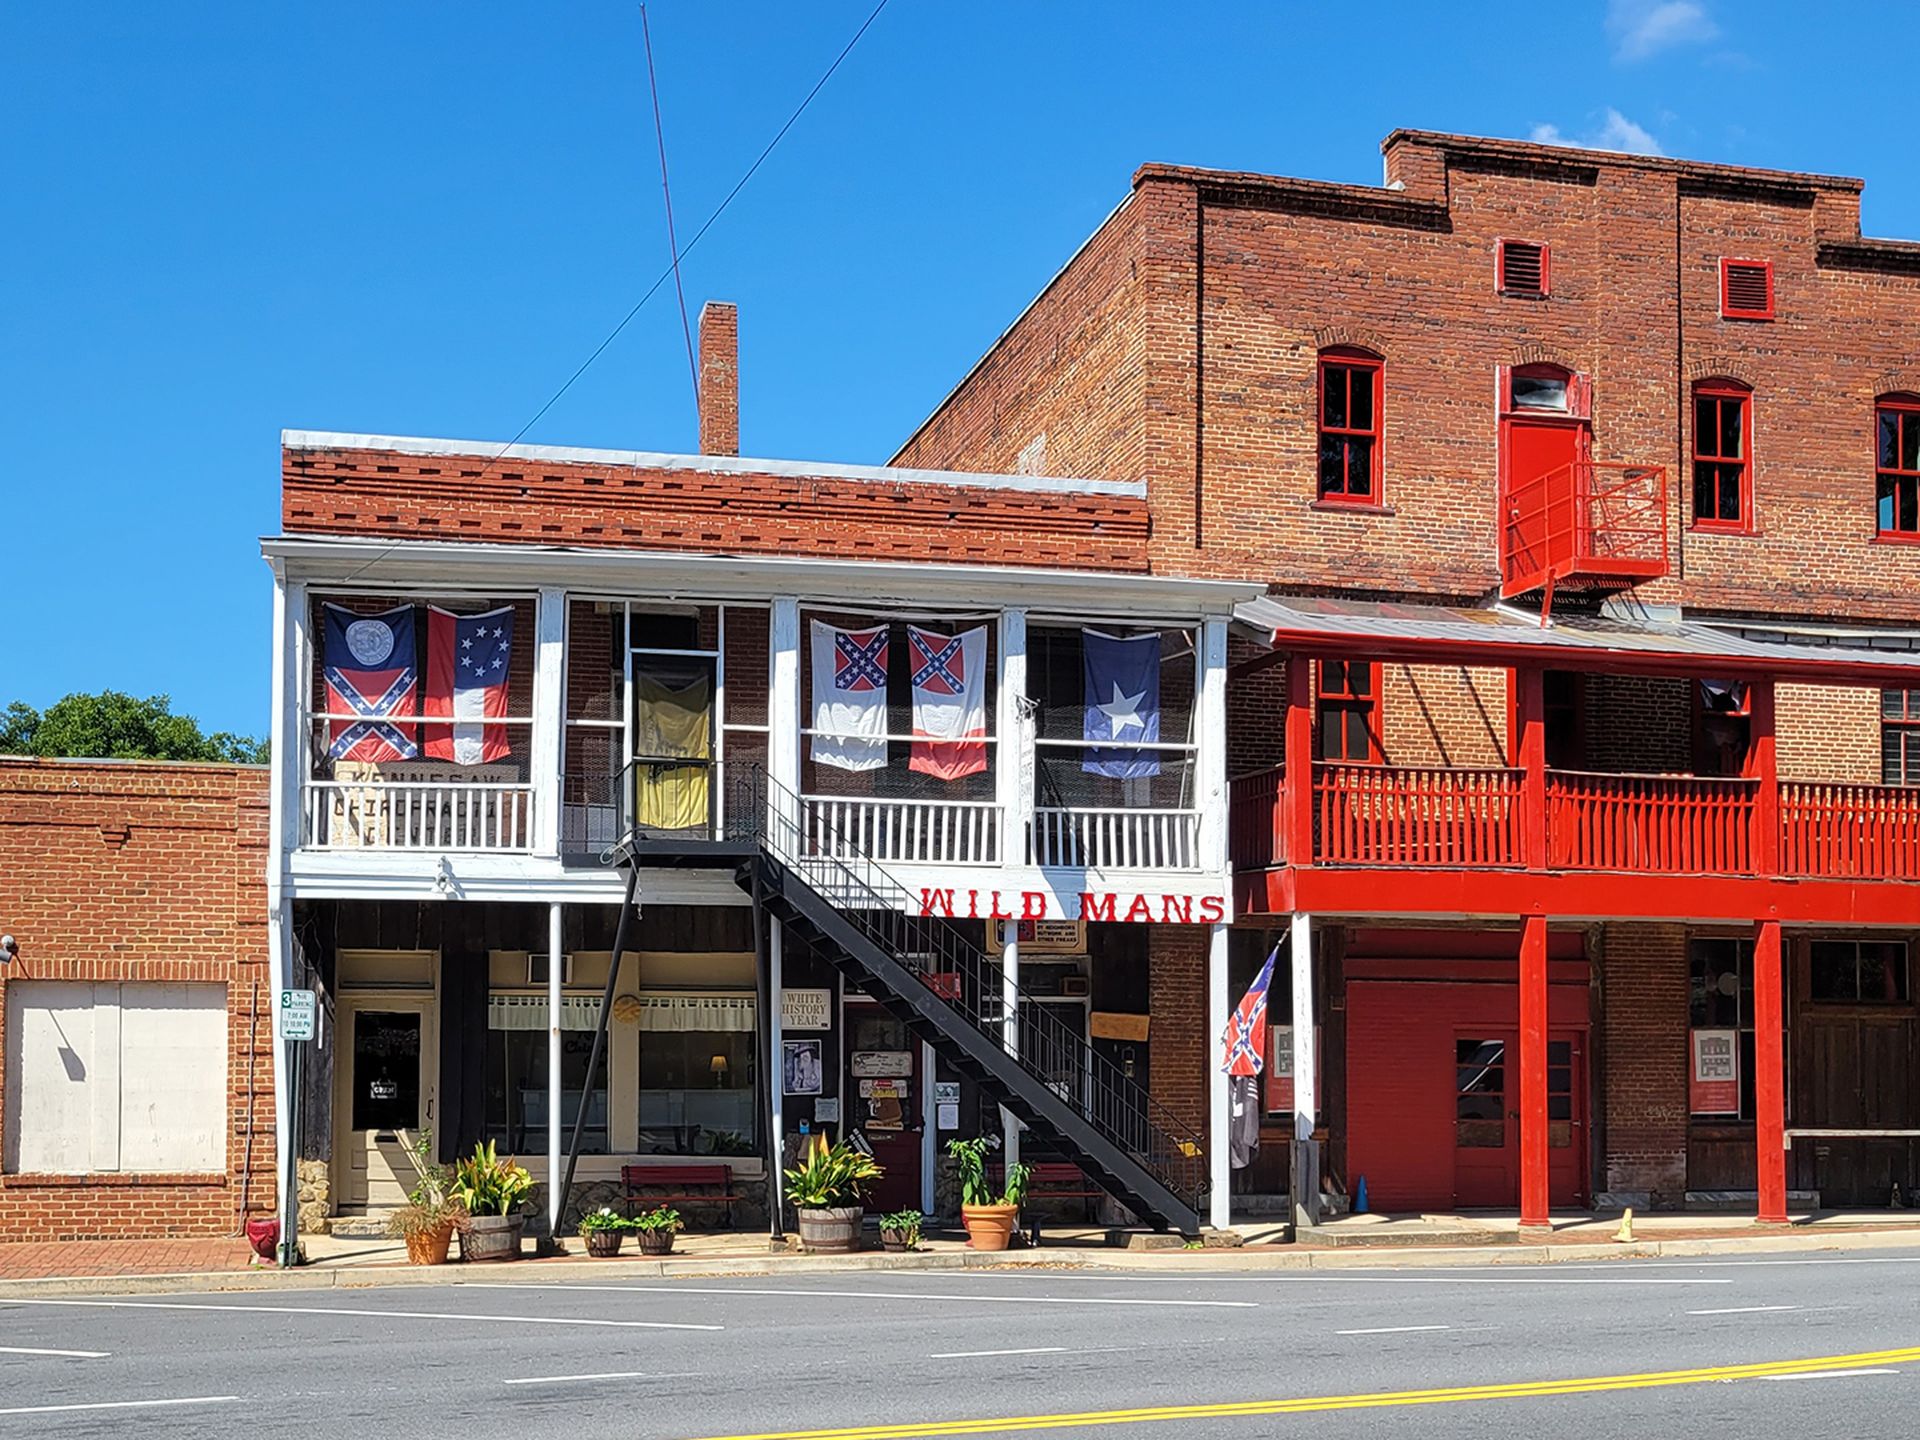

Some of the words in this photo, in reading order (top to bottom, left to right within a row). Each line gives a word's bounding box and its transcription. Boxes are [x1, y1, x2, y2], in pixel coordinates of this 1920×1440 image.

[919, 888, 1047, 921] WILD
[1077, 892, 1225, 923] MANS
[283, 993, 291, 1006] 3
[787, 993, 823, 1004] WHITE
[782, 1003, 826, 1015] HISTORY
[790, 1015, 819, 1026] YEAR
